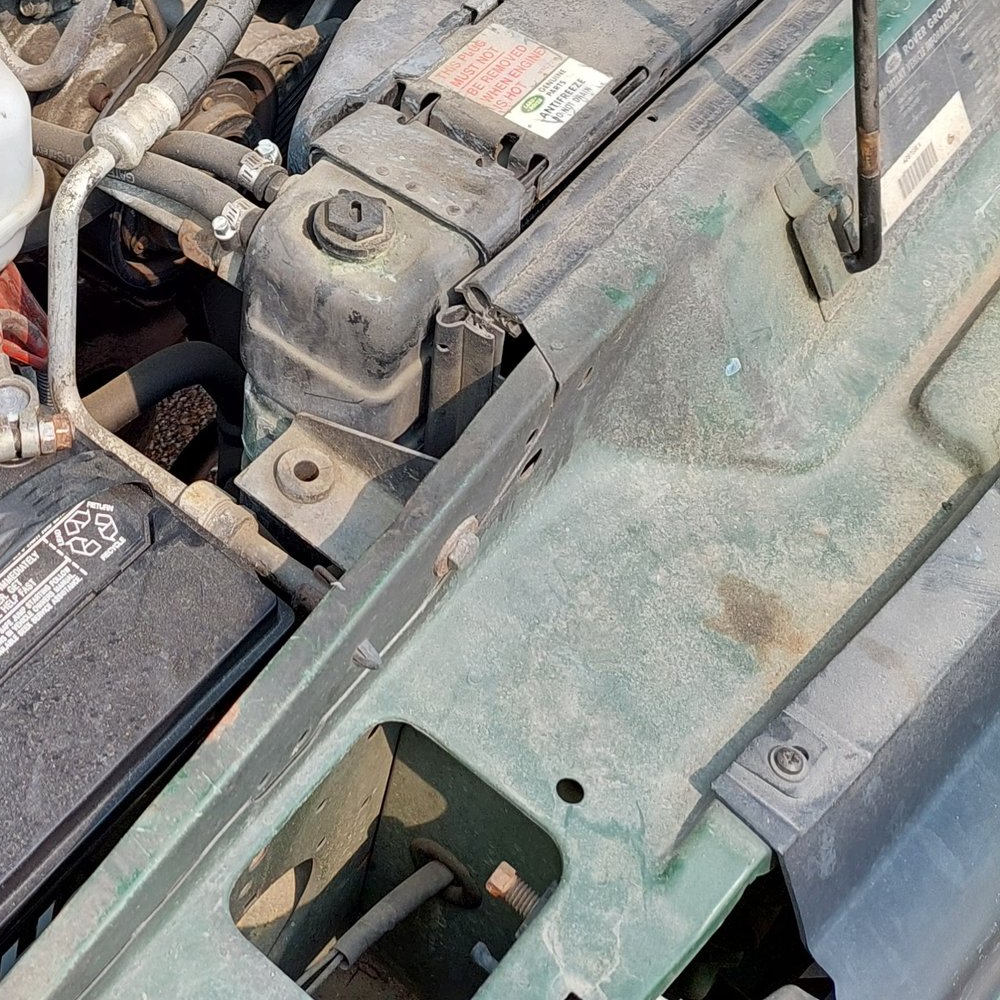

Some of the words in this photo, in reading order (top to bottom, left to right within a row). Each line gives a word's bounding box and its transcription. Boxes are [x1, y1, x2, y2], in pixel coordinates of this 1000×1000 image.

[902, 25, 925, 55] ROVER
[435, 60, 462, 80] THIS
[457, 39, 486, 61] PLUG
[449, 64, 480, 86] MUST
[476, 46, 499, 64] NOT
[466, 80, 487, 95] BE
[481, 45, 527, 81] REMOVED
[480, 77, 512, 102] WHEN
[508, 47, 547, 77] ENGINE
[538, 69, 566, 91] GENUINE
[546, 80, 565, 96] PARTS
[492, 99, 508, 109] IS
[502, 81, 528, 100] HOT
[539, 79, 585, 117] ANTIFREEZE
[560, 102, 575, 112] NOT
[572, 86, 592, 102] DRAIN
[100, 537, 126, 561] RECYCLE
[0, 594, 19, 612] HELP
[16, 578, 37, 596] FAST
[5, 579, 22, 594] GET
[24, 584, 51, 608] STARTING
[48, 565, 71, 586] FOLLOW
[11, 610, 34, 631] VEHICLE
[30, 602, 53, 623] SERVICE
